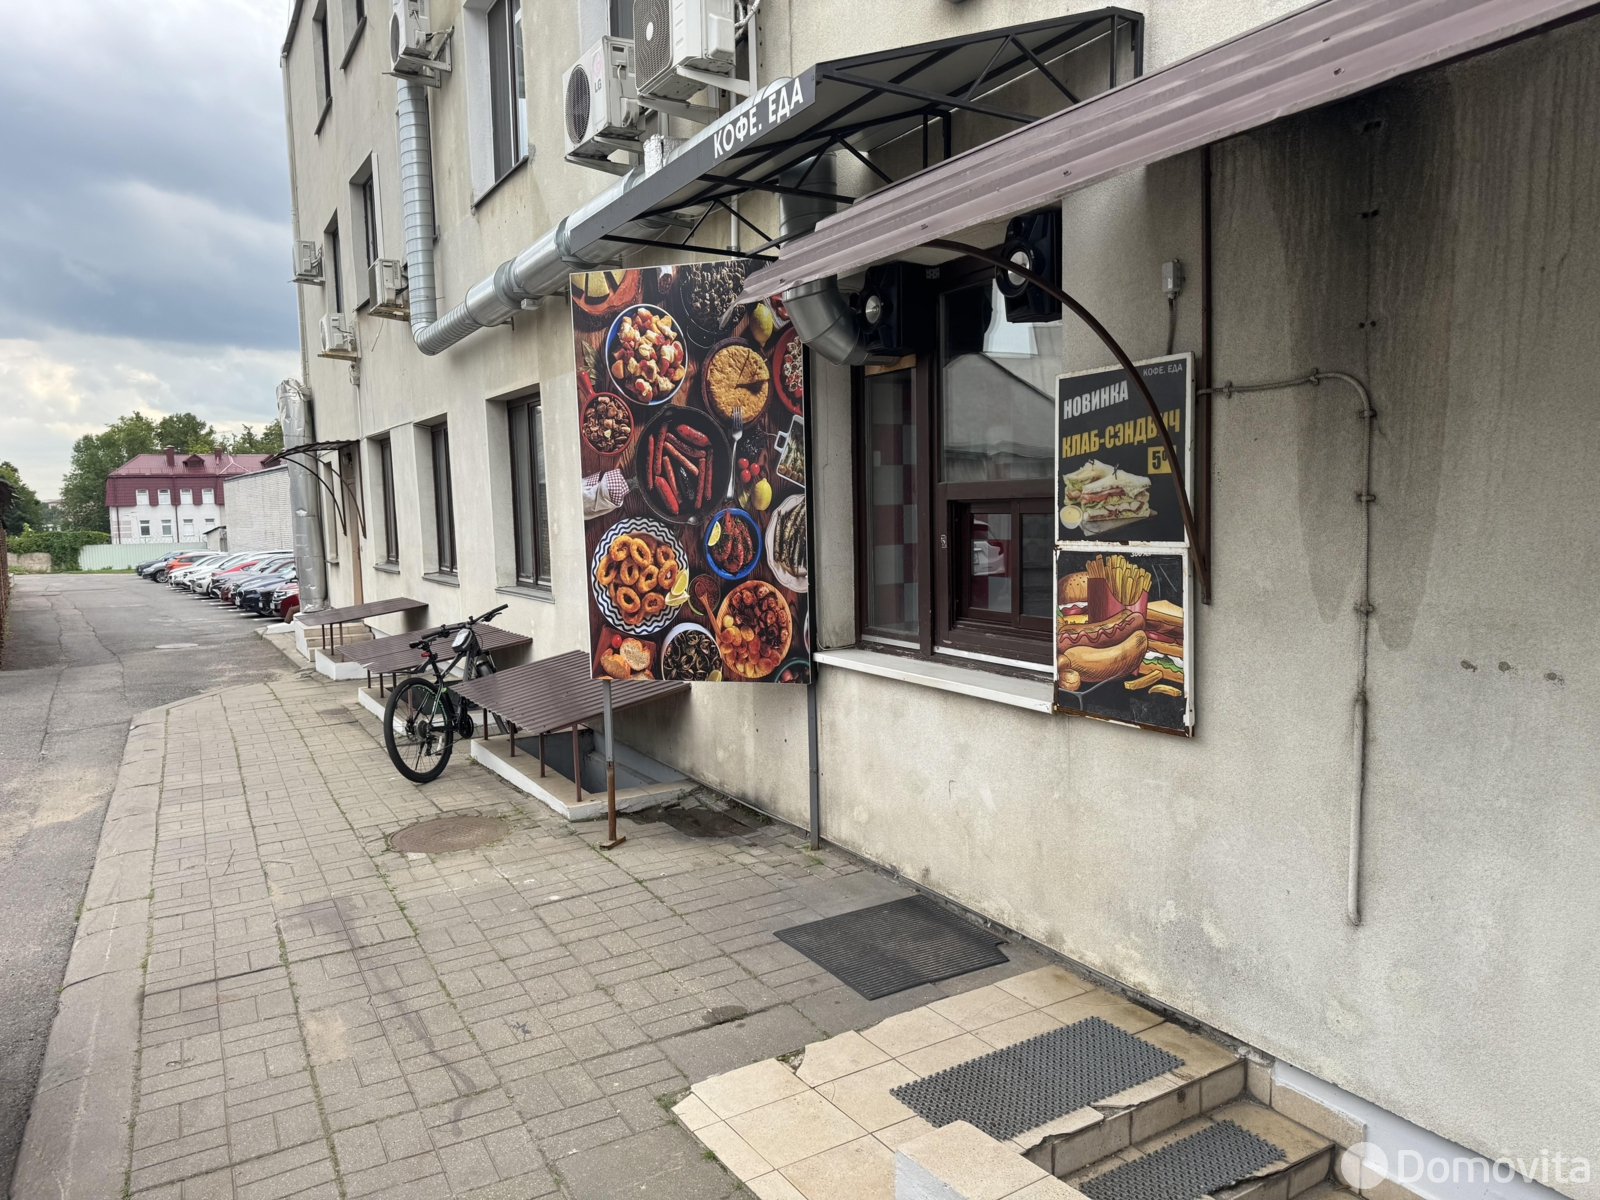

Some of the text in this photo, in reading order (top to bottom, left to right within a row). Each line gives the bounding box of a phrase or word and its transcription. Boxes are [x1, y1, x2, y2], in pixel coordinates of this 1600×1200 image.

[594, 78, 602, 93] LG
[713, 77, 804, 159] КОФЕ. ЕДА
[1142, 363, 1183, 377] КОФЕ. ЕДА
[1063, 380, 1129, 420] НОВИНКА
